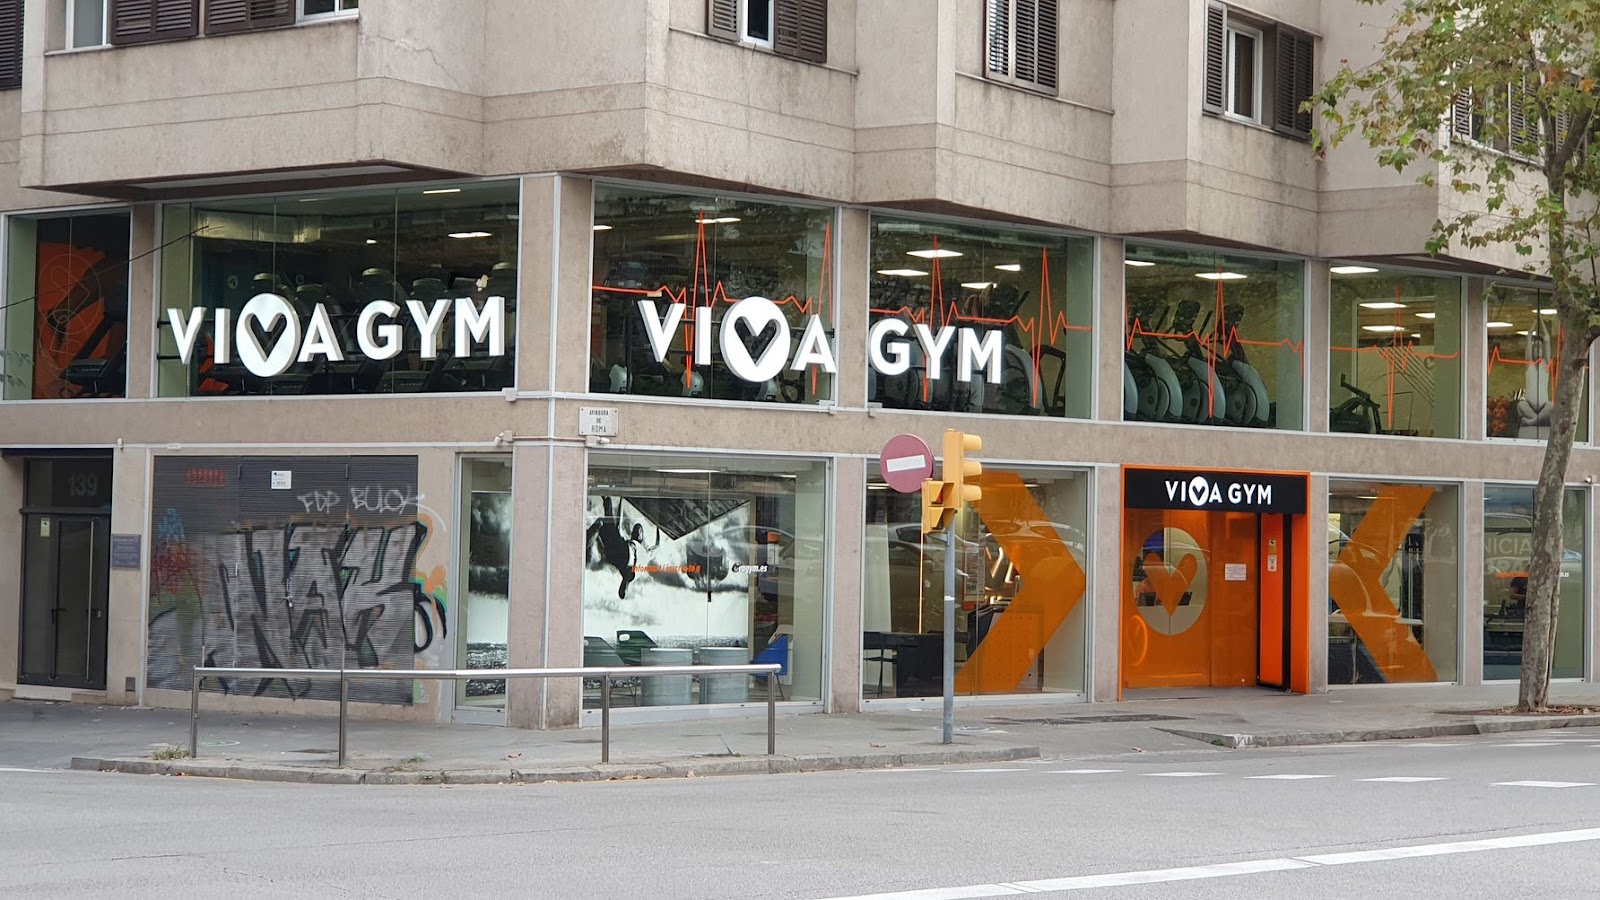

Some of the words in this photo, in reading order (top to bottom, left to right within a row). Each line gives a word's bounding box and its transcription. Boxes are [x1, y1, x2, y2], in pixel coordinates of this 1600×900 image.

[167, 293, 344, 377] VIVA
[356, 296, 505, 361] GYM
[638, 296, 837, 382] VIVA
[868, 318, 1003, 384] GYM
[591, 425, 607, 433] ROMA
[68, 472, 98, 497] 139
[1165, 476, 1223, 506] VIVA
[1228, 482, 1272, 505] GYM
